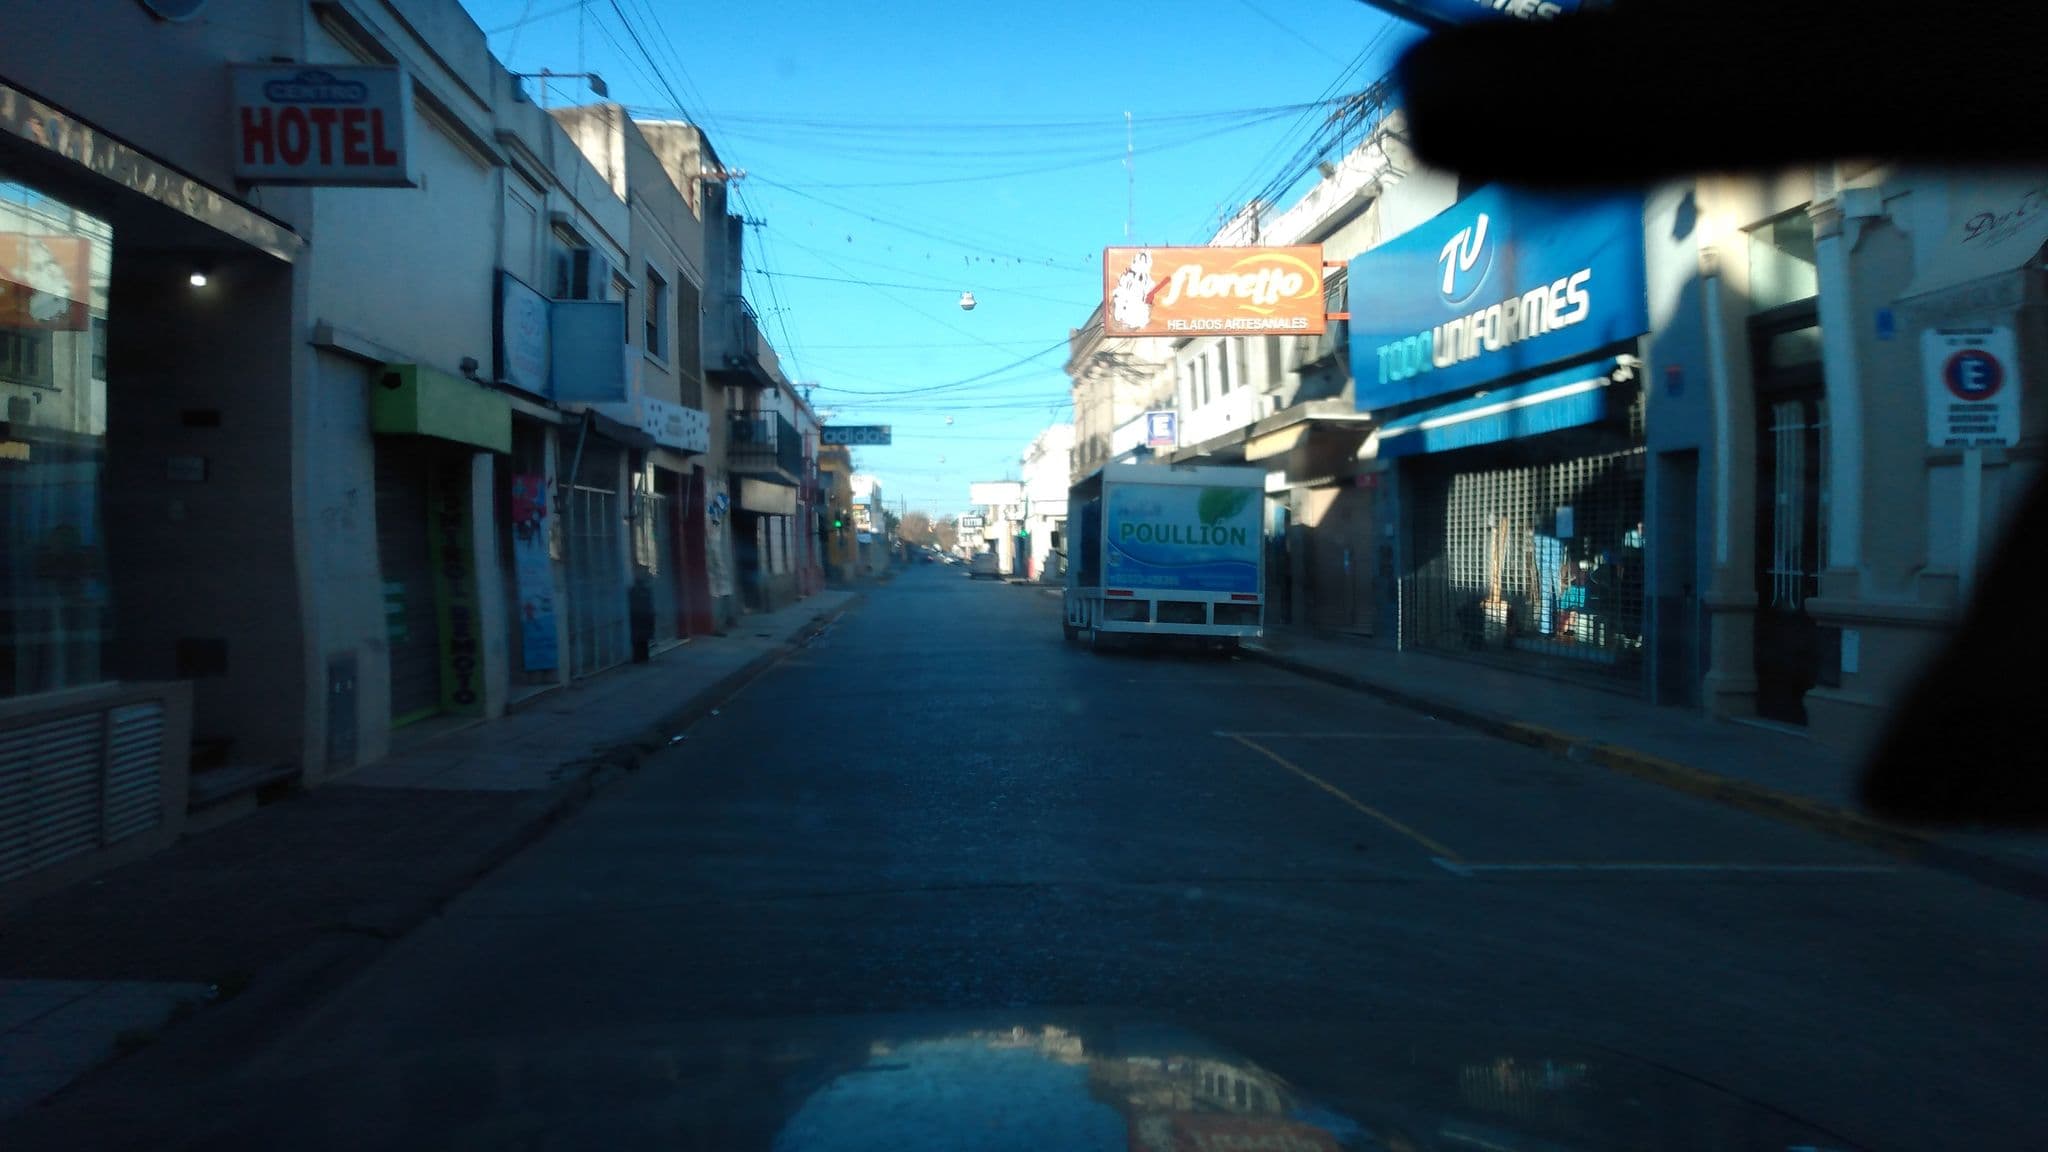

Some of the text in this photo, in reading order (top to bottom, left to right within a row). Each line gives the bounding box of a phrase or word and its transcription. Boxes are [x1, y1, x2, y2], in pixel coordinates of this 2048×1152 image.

[241, 107, 397, 165] HOTEL
[1438, 213, 1489, 295] TU
[1167, 317, 1308, 331] HELADOS ARTESANALES
[1960, 360, 1986, 390] E
[824, 428, 889, 444] adidas
